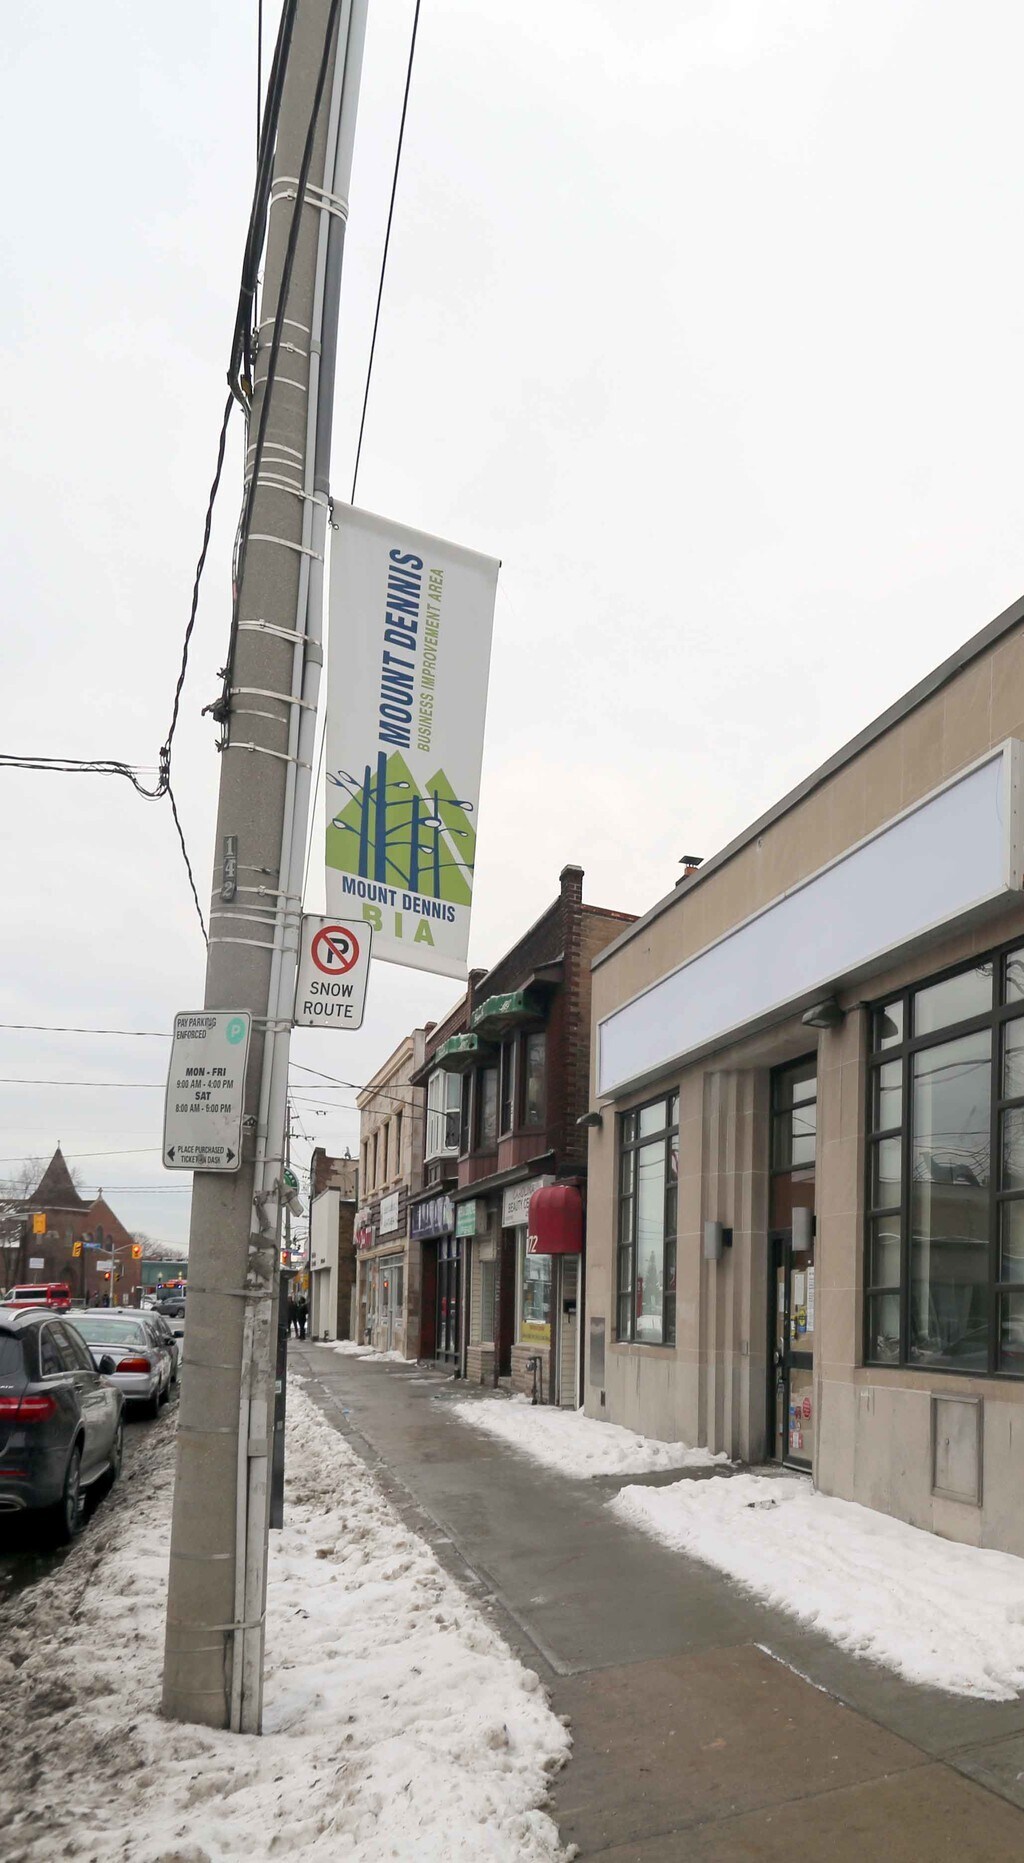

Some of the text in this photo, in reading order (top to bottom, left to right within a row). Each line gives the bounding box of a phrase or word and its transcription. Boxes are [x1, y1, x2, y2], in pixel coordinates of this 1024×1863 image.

[378, 549, 424, 749] MOUNT DENNIS
[417, 568, 444, 752] BUSINESS IMPROVEMENT AREA
[222, 837, 236, 897] 142
[342, 875, 455, 922] MOUNT DENNIS
[362, 902, 435, 947] BIA
[310, 981, 354, 997] SNOW
[303, 1001, 354, 1018] ROUTE
[177, 1017, 217, 1028] PAY PARKING
[176, 1030, 207, 1040] ENFORCED
[185, 1067, 205, 1077] MON
[212, 1067, 227, 1077] FRI
[190, 1079, 202, 1089] AM
[207, 1080, 221, 1089] 4:00
[222, 1079, 234, 1089] PM
[194, 1091, 211, 1101] SAT
[189, 1103, 201, 1113] AM
[220, 1103, 231, 1113] PM
[177, 1145, 225, 1154] PLACE PURCHASED
[181, 1155, 198, 1164] TICKET
[207, 1155, 221, 1164] DASH
